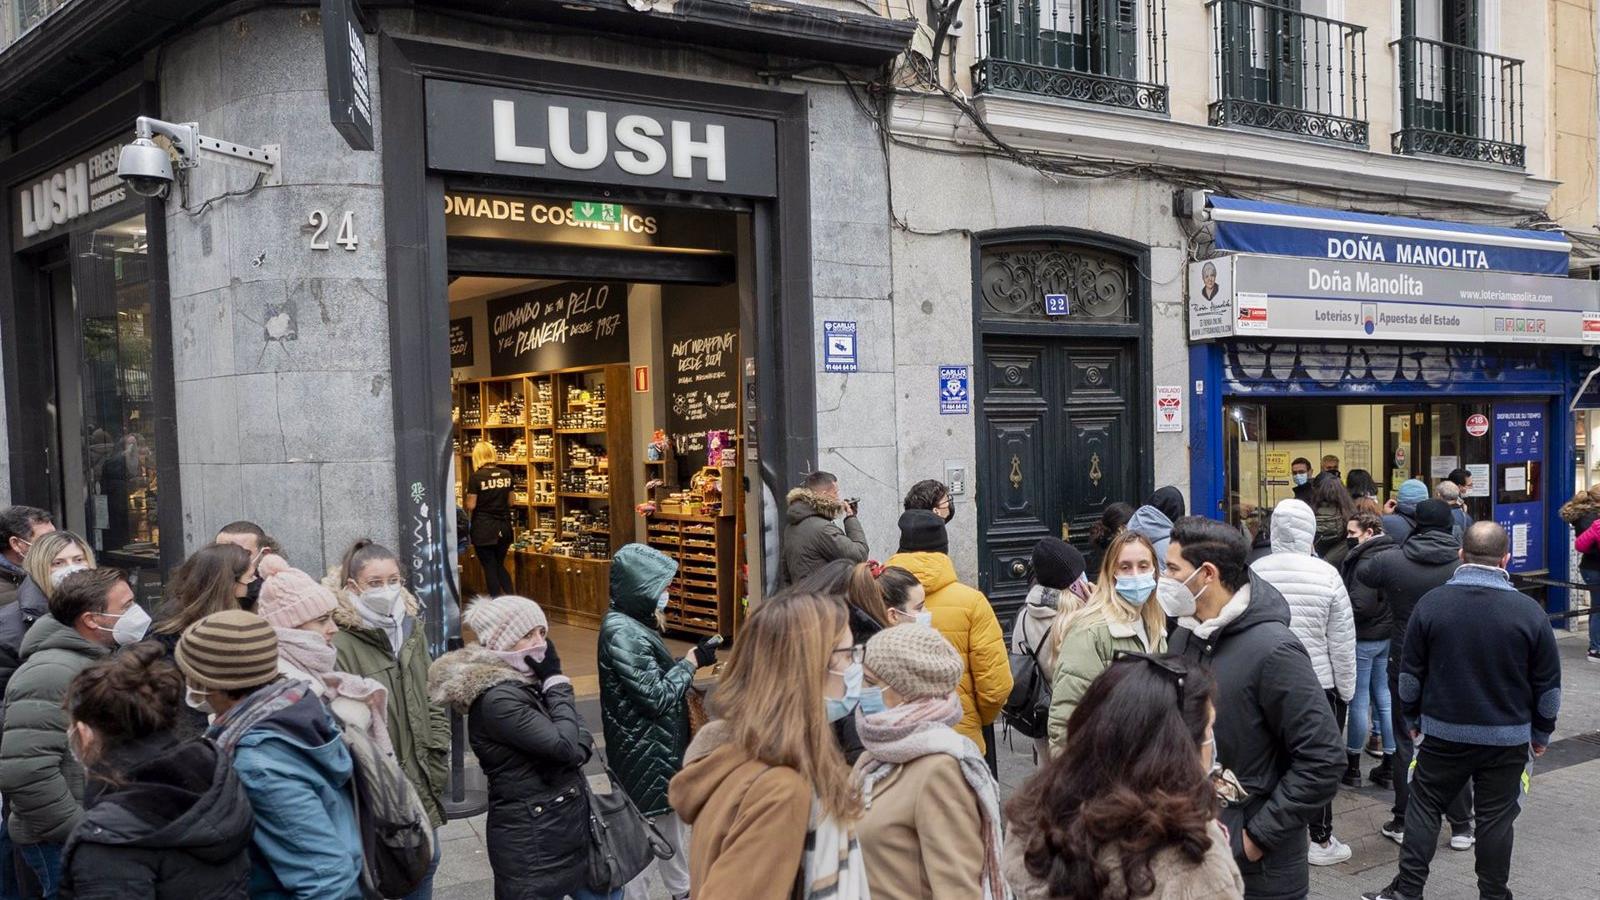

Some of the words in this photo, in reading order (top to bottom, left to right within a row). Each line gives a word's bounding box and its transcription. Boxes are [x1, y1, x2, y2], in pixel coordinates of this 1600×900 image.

[492, 98, 726, 182] LUSH
[21, 162, 89, 238] LUSH
[309, 209, 359, 252] 24
[530, 204, 658, 235] COSICS
[1327, 235, 1385, 262] DOÑA
[1396, 243, 1490, 269] MANOLITA
[1308, 267, 1351, 291] Doña
[1355, 271, 1424, 297] Manolita
[1459, 289, 1553, 303] www.loteriamanolita.com
[493, 301, 540, 336] CUIDANDO
[566, 285, 609, 320] PELO
[1050, 298, 1065, 311] 22
[1354, 312, 1360, 325] y
[1379, 311, 1418, 326] Apuestas
[1419, 312, 1432, 325] del
[1433, 314, 1461, 327] Estado
[514, 318, 569, 358] PLANETA
[570, 321, 593, 336] DESDE
[595, 314, 622, 340] 1987
[480, 476, 512, 491] LUSH
